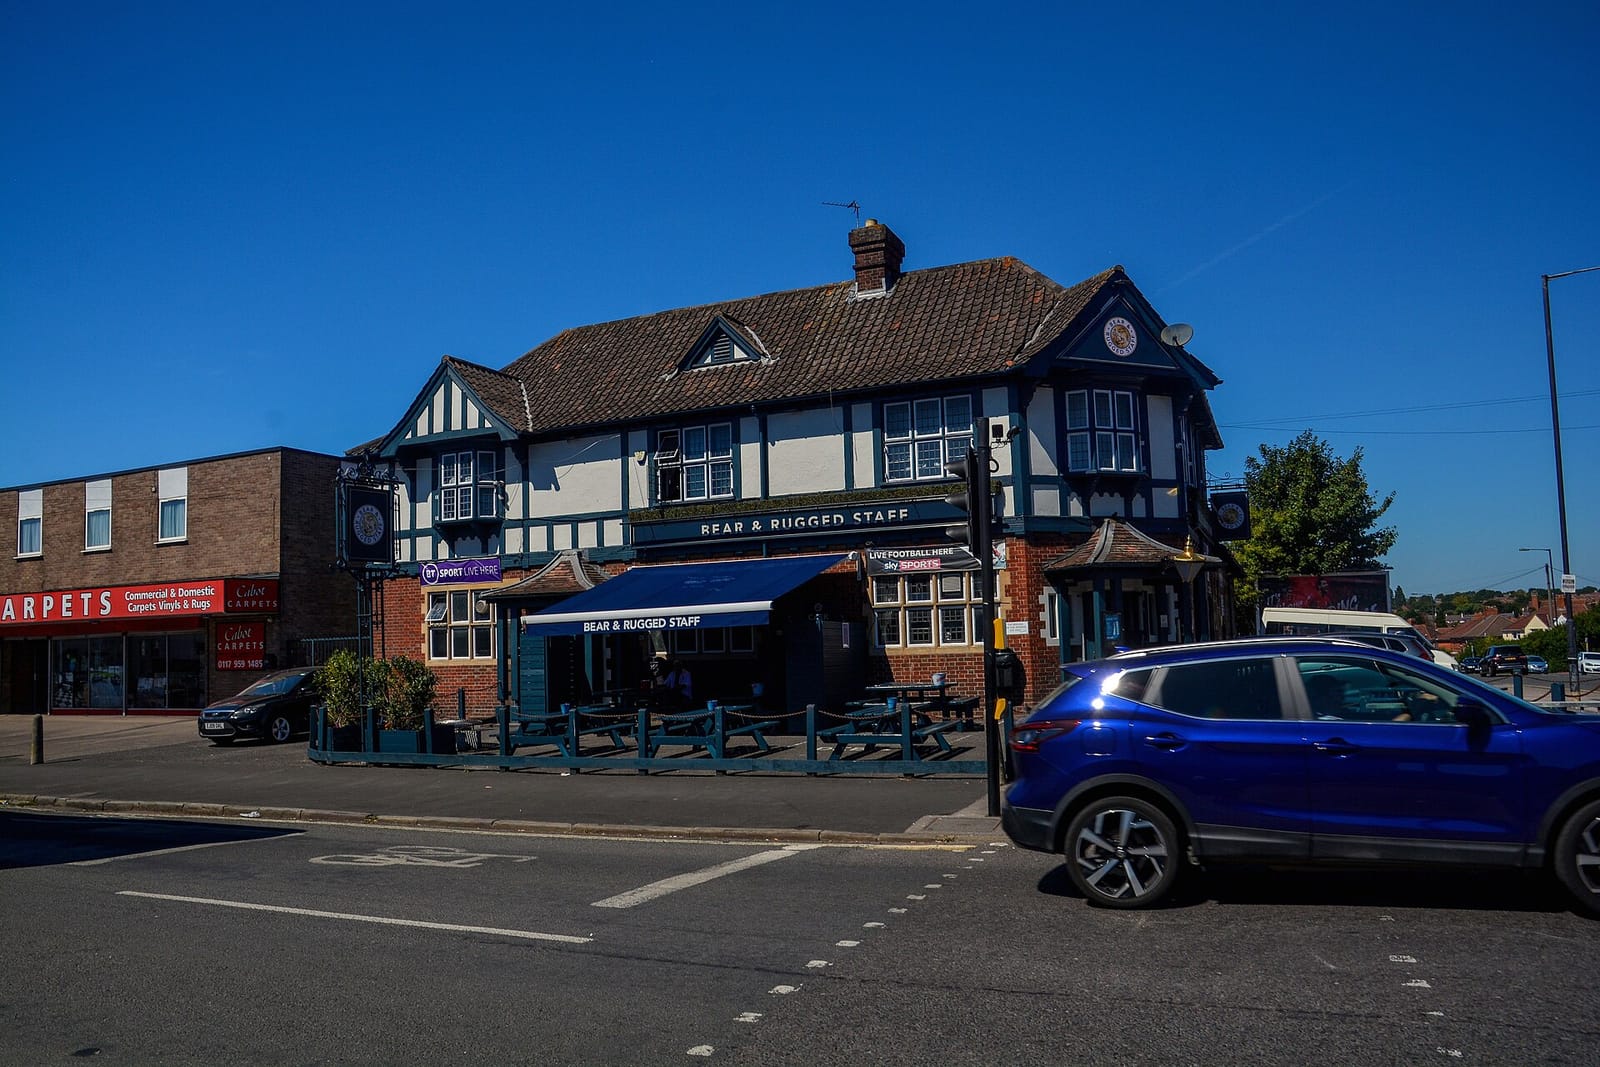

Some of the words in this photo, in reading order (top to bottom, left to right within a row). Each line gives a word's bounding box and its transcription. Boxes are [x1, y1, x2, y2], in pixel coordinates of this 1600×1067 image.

[701, 522, 744, 536] BEAR
[751, 520, 762, 531] &
[770, 513, 845, 530] RUGGED
[853, 508, 909, 525] STAFF
[869, 551, 887, 559] LIVE
[888, 549, 930, 558] FOOTBALL
[931, 548, 954, 556] HERE
[426, 569, 436, 578] BT
[440, 567, 463, 578] SPORT
[464, 566, 479, 577] LIVE
[480, 564, 499, 575] HERE
[884, 561, 899, 571] sky
[900, 560, 939, 569] SPORTS
[125, 589, 168, 601] Commercial
[170, 588, 176, 598] &
[178, 585, 215, 597] Domestic
[1, 591, 112, 621] ARPETS
[128, 602, 156, 614] Carpets
[159, 600, 181, 612] Vinyls
[183, 600, 189, 609] &
[191, 599, 211, 611] Rugs
[227, 600, 278, 608] CARPETS
[583, 621, 610, 632] BEAR
[612, 620, 621, 630] &
[623, 618, 667, 630] RUGGED
[669, 616, 701, 628] STAFF
[217, 641, 264, 651] CARPETS
[217, 660, 232, 669] 0117
[234, 659, 246, 668] 959
[248, 659, 263, 668] 1485
